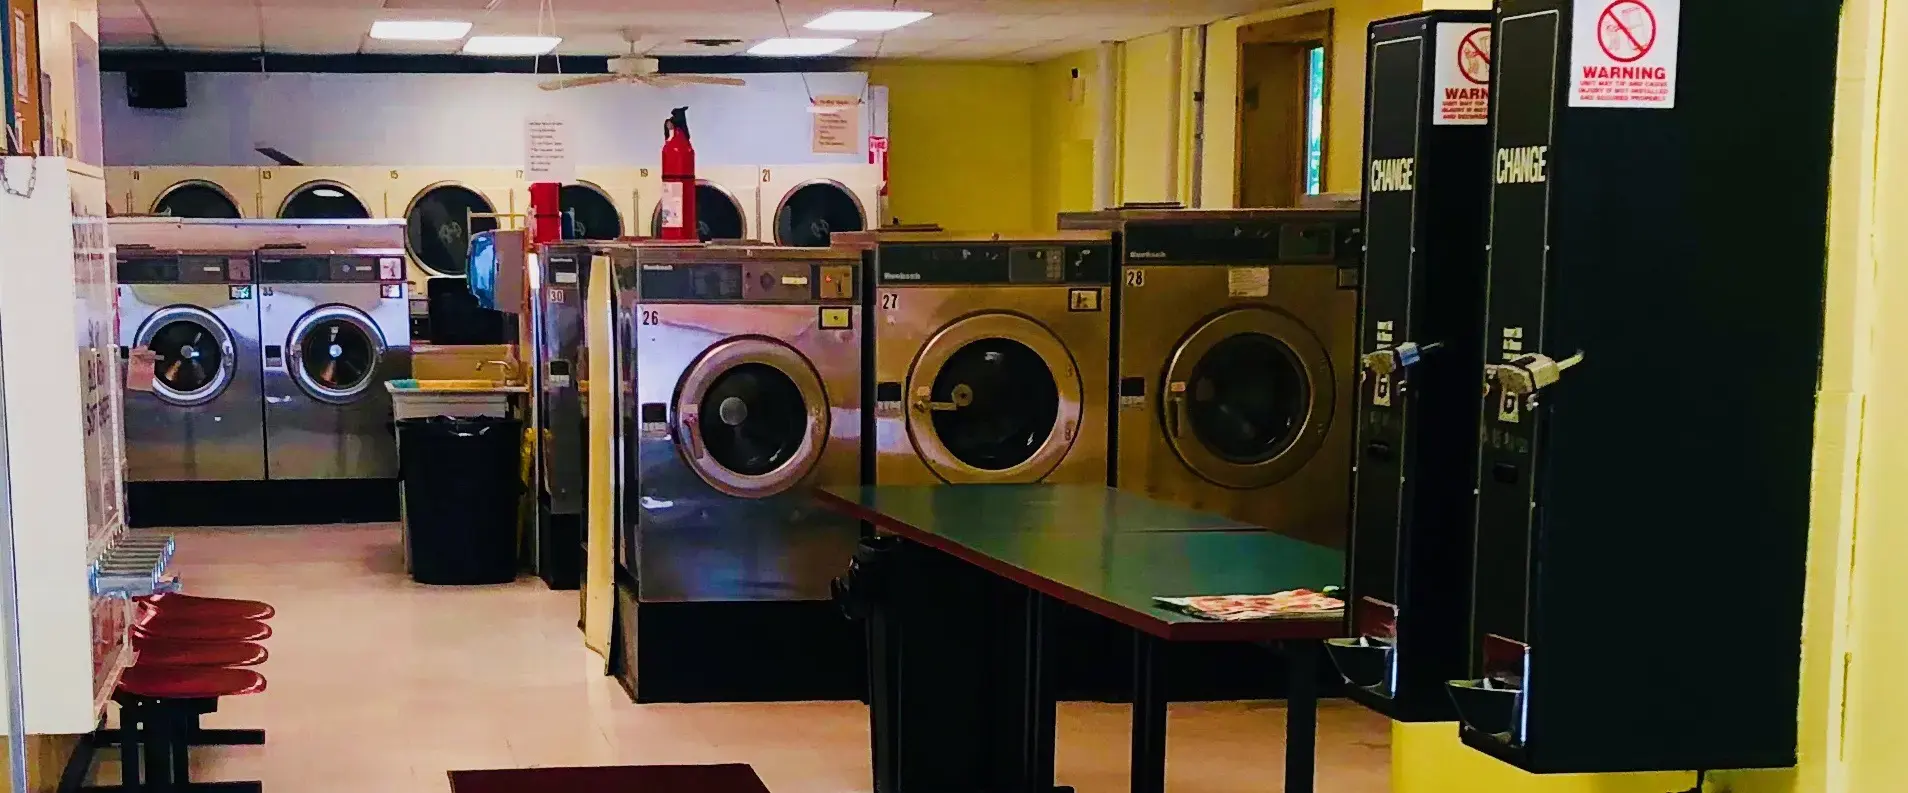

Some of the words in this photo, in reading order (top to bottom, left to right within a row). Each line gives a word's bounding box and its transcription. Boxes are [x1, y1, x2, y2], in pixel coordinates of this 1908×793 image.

[1583, 66, 1666, 79] WARNING
[1445, 88, 1489, 99] WARN
[1497, 146, 1547, 184] CHANGE
[762, 168, 770, 182] 21
[1371, 158, 1413, 192] CHANGE
[1128, 271, 1142, 286] 28
[551, 290, 562, 301] 30
[883, 293, 898, 309] 27
[643, 310, 659, 325] 26
